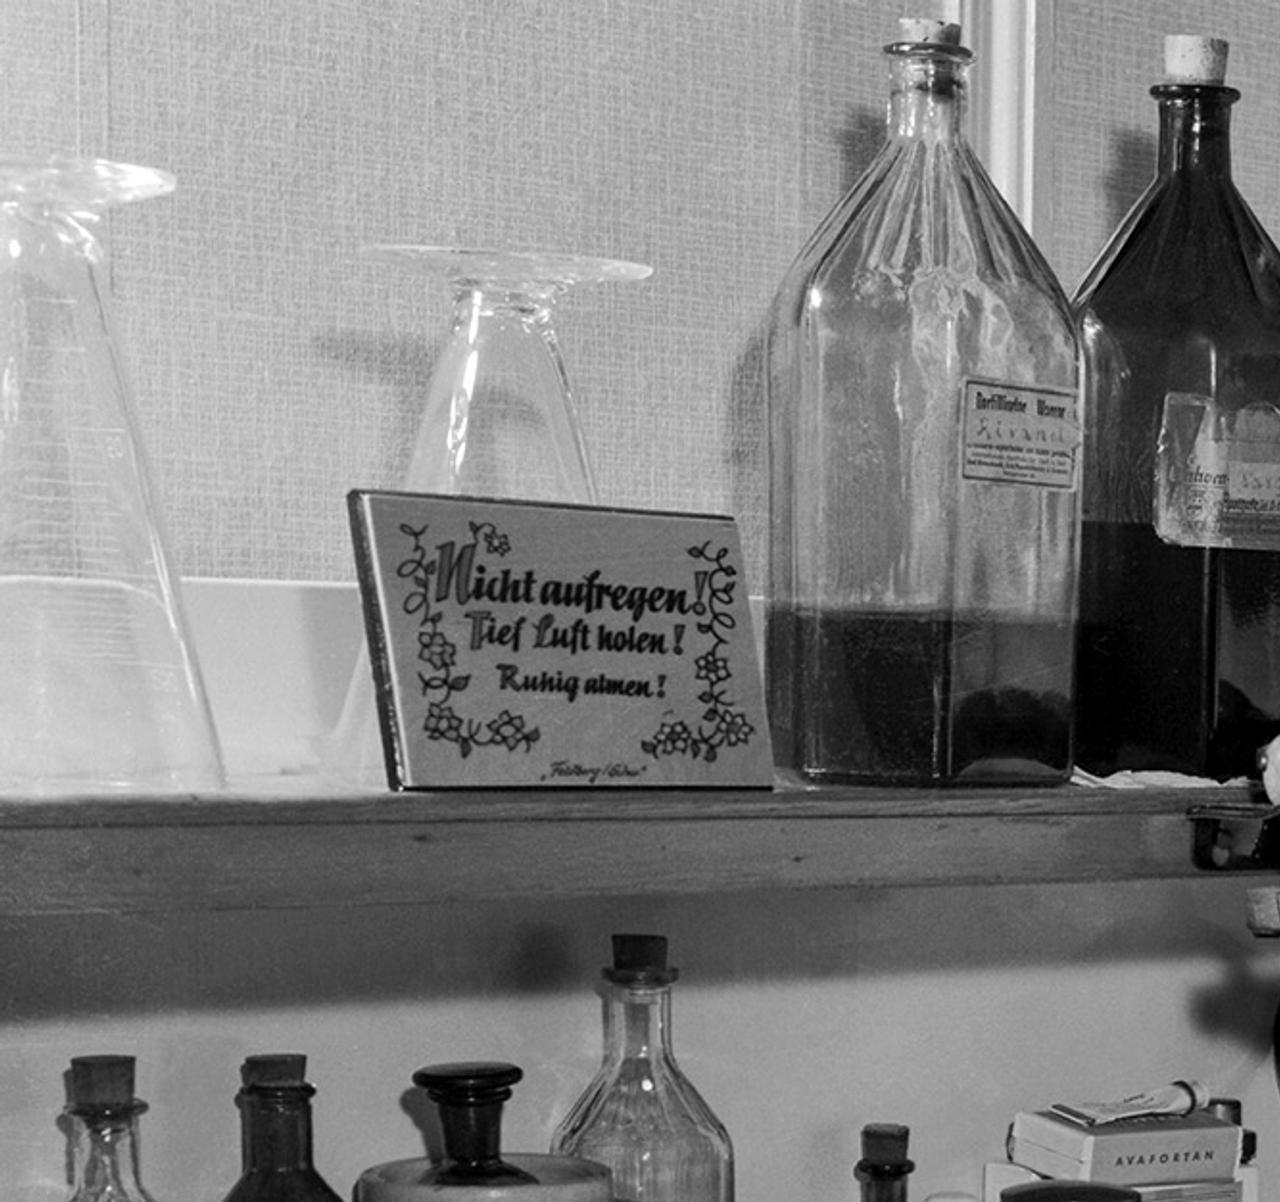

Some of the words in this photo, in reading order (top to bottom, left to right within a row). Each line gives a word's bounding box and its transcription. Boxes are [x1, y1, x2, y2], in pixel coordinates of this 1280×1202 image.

[435, 540, 537, 606] Nicht
[464, 610, 527, 653] Tief
[532, 612, 591, 655] Luft
[495, 662, 580, 703] Ruhig
[1115, 1149, 1215, 1167] AVAFORTAN
